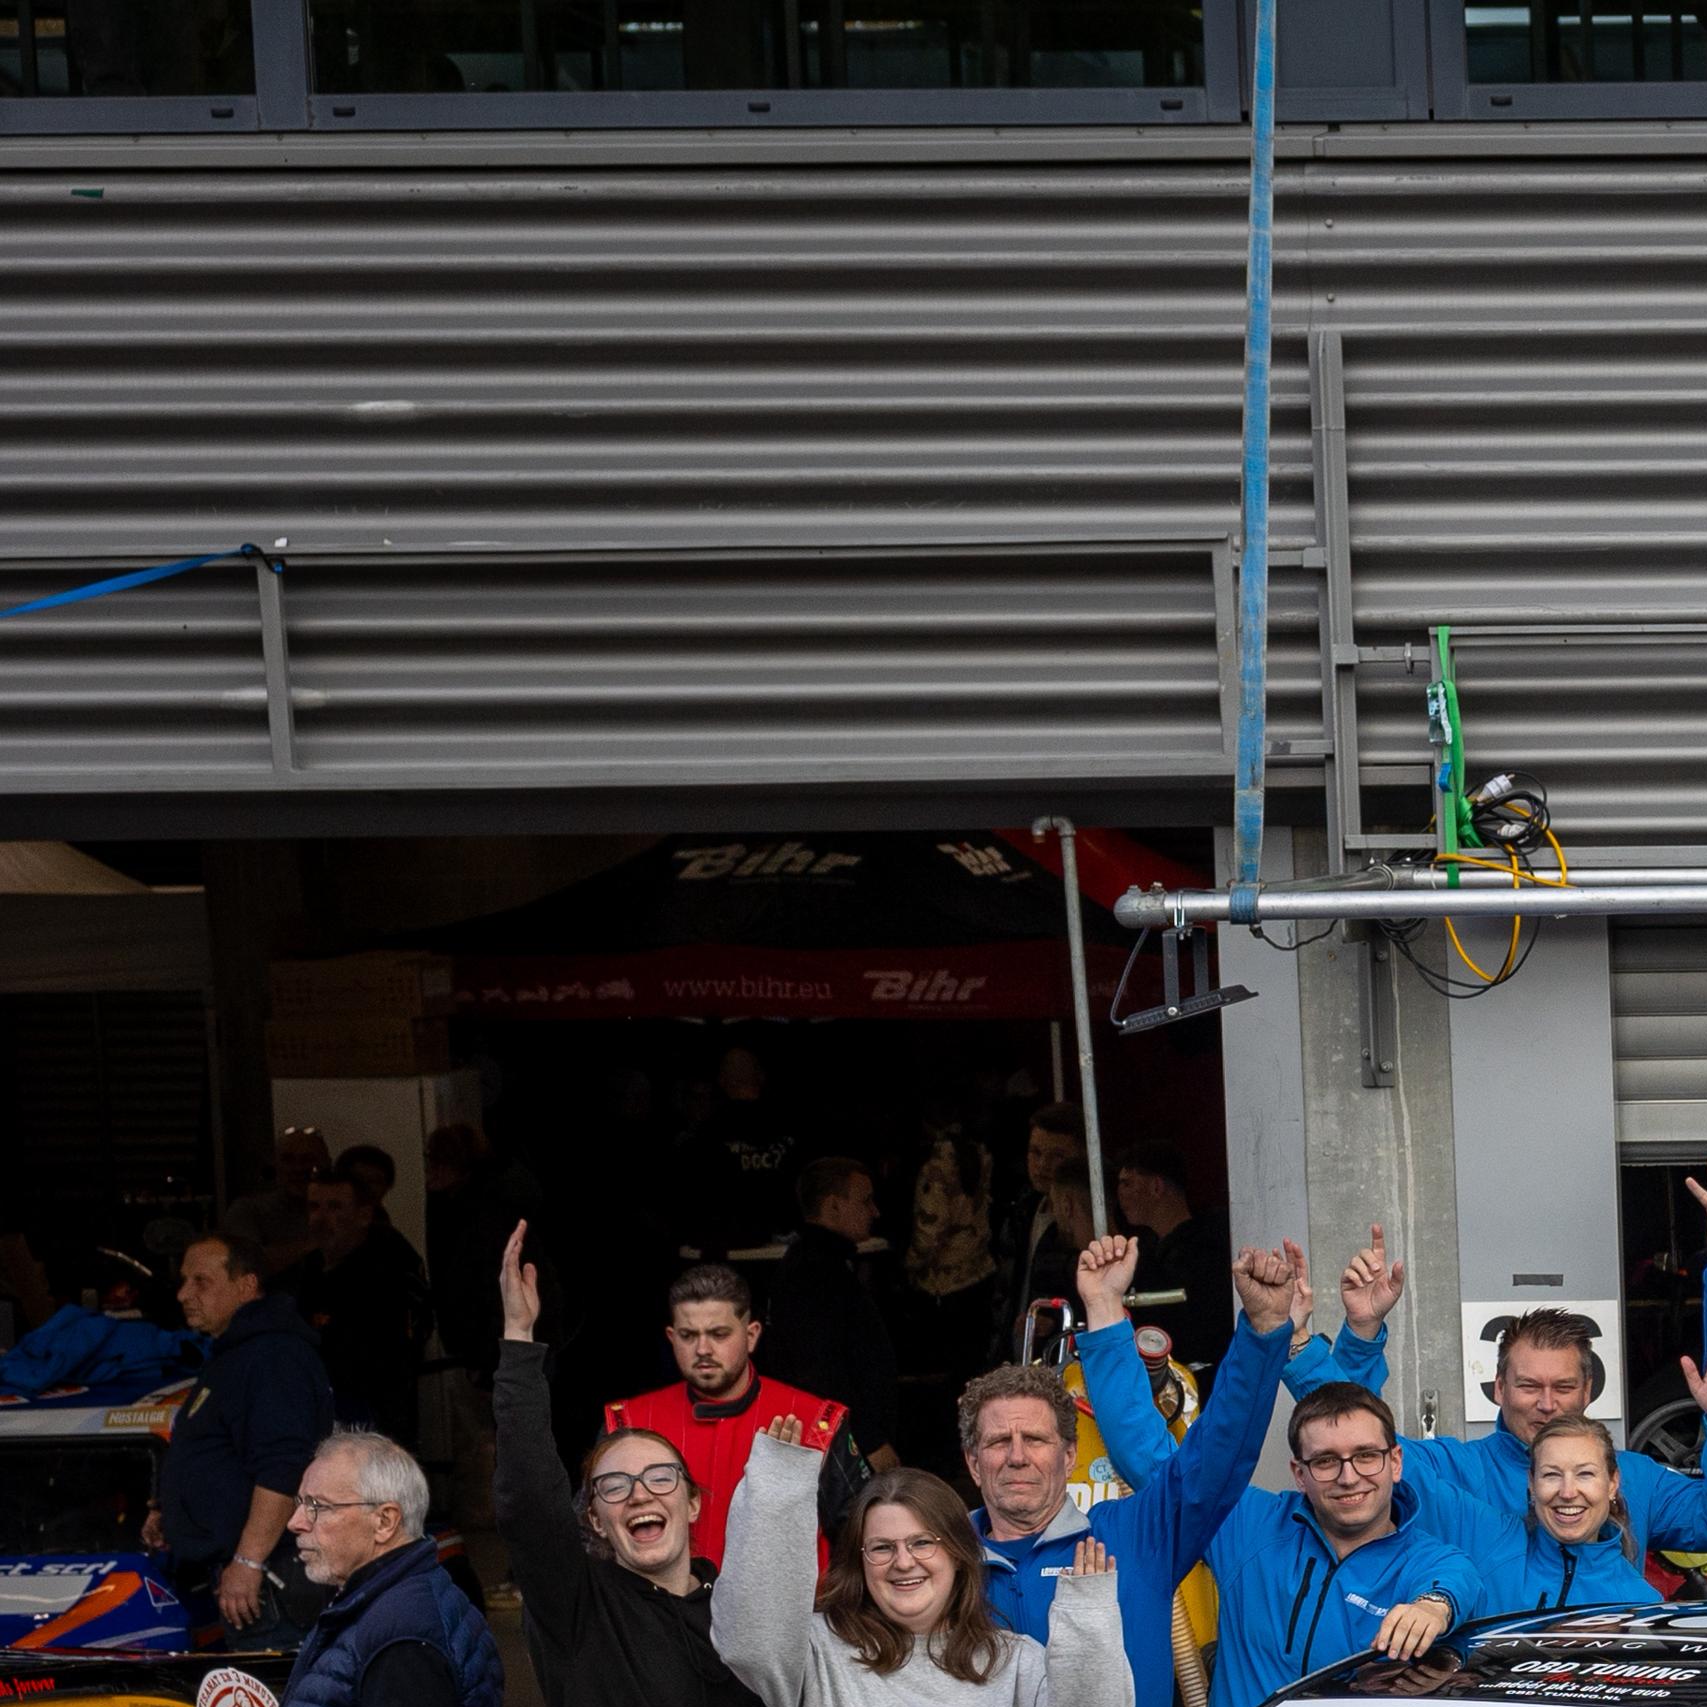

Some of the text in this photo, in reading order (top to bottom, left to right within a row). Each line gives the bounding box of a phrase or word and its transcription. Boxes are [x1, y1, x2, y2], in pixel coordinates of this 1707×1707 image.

[673, 841, 863, 882] Bihr
[663, 974, 833, 1001] www.bihr.eu
[863, 969, 989, 1002] Bihr
[1468, 1638, 1648, 1650] SAVING
[1510, 1660, 1580, 1675] OBD
[1578, 1663, 1701, 1682] TUNING
[1633, 1687, 1672, 1698] auto
